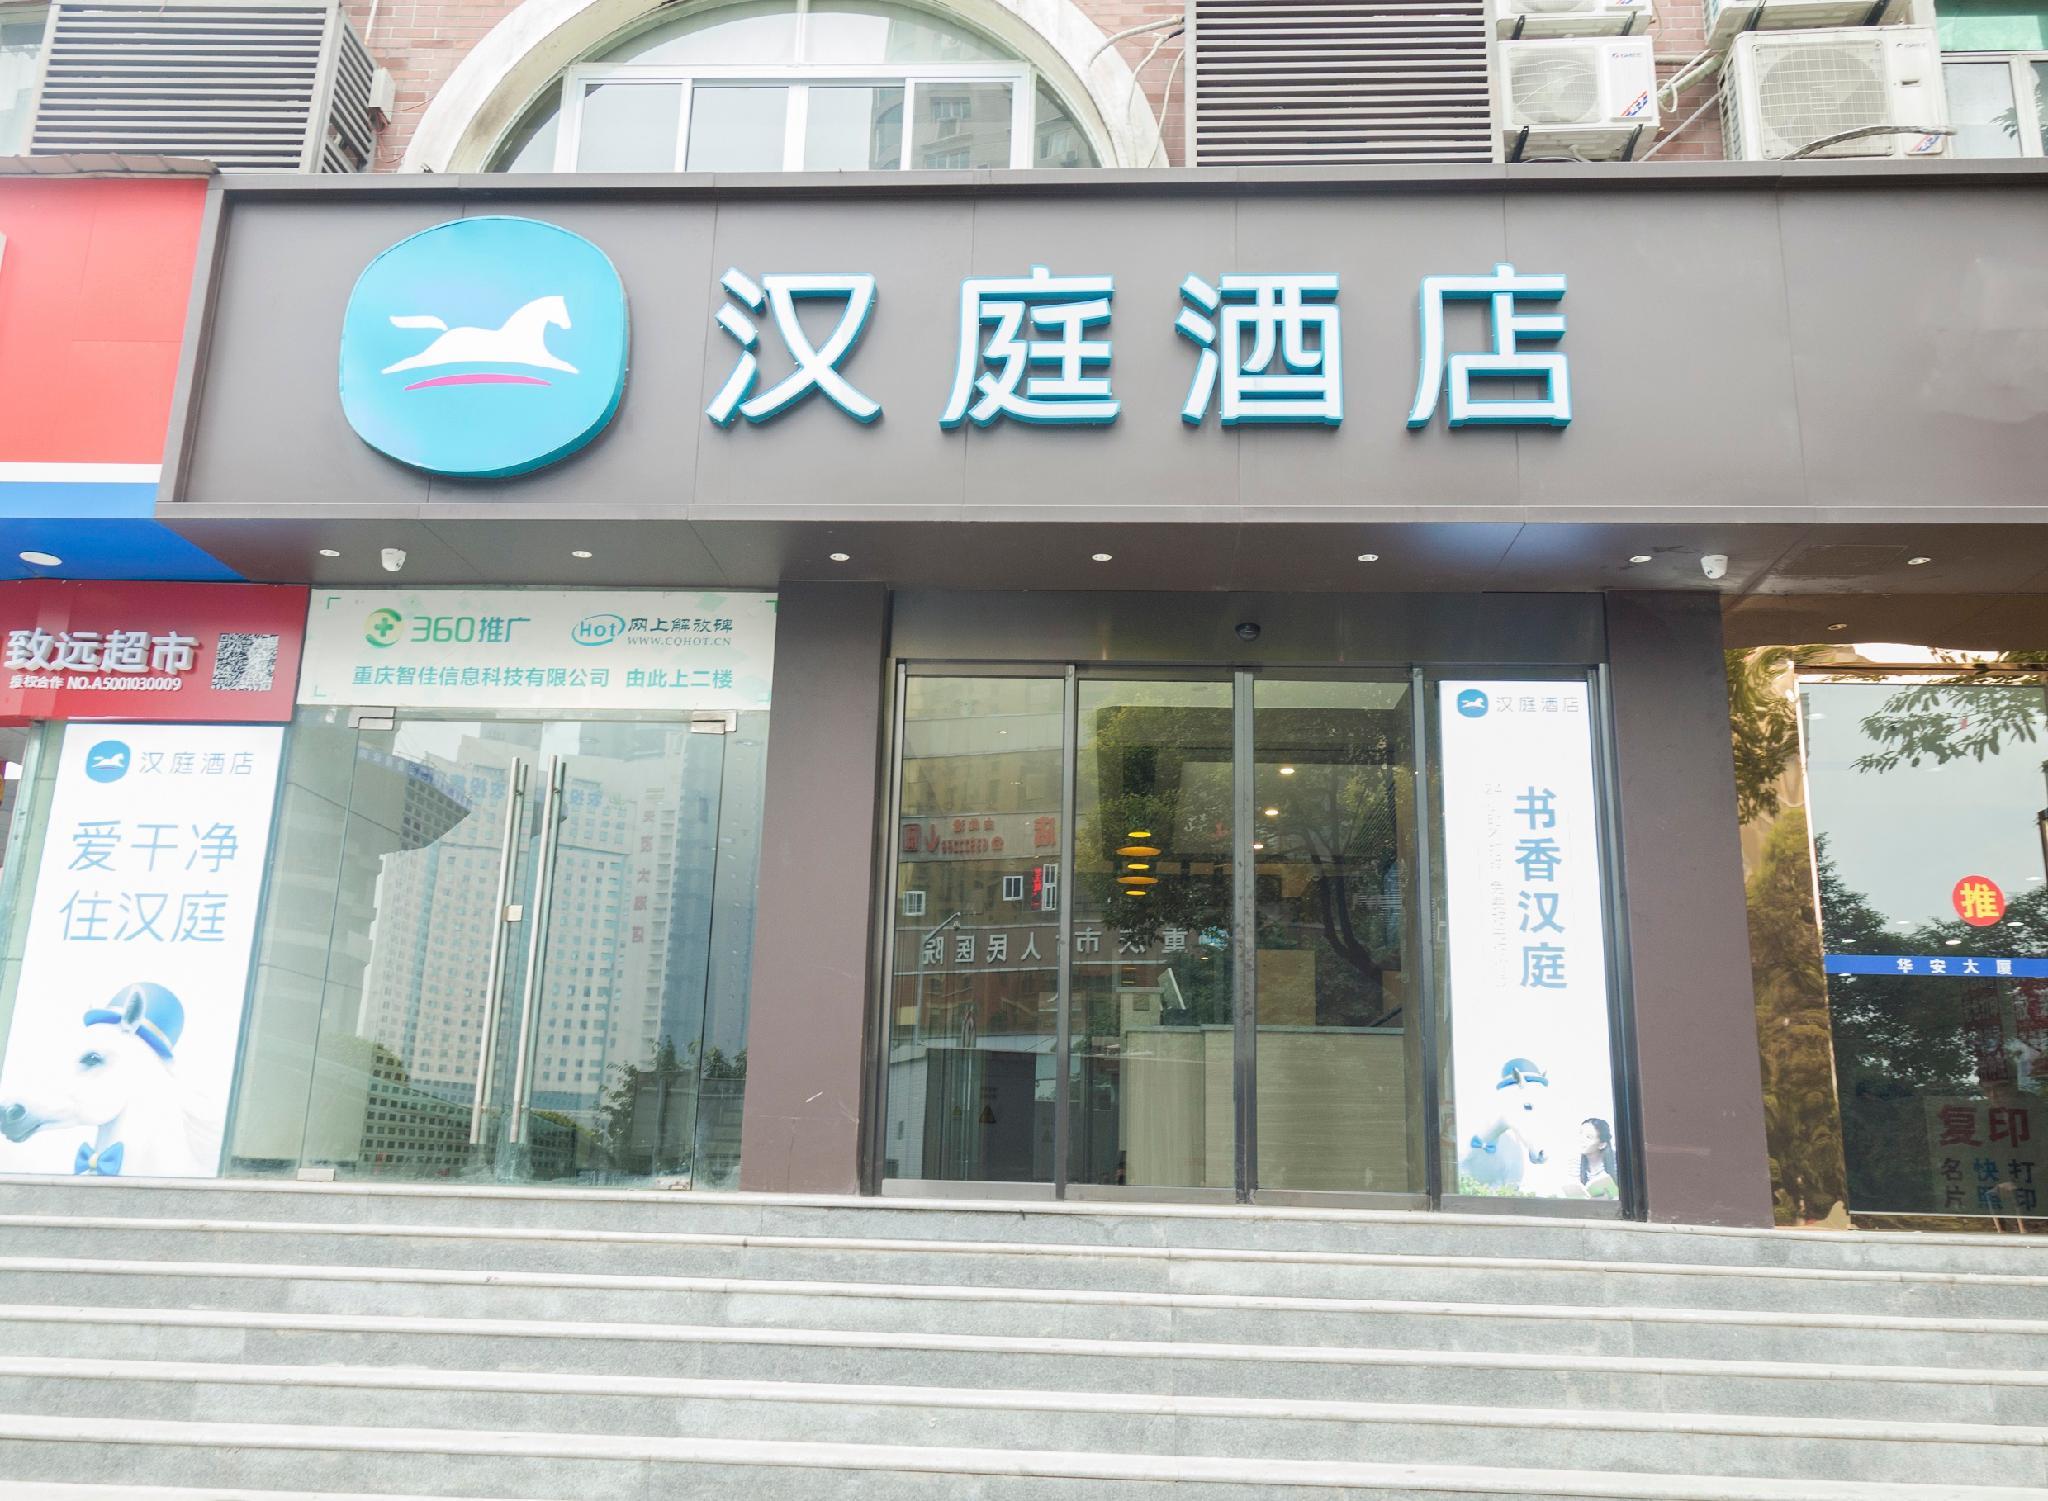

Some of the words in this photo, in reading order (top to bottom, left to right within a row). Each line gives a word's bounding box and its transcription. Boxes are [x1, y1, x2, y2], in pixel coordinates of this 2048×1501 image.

[703, 263, 1573, 429] 汉庭酒店
[410, 616, 532, 643] 360推广
[627, 616, 734, 635] 网上解放碑
[3, 627, 200, 675] 致远超市
[352, 666, 610, 688] 重庆智佳信息科技有限公司
[625, 668, 733, 689] 由此上二楼
[1495, 694, 1580, 714] 汉庭酒店
[138, 750, 255, 776] 汉庭酒店
[67, 819, 239, 873] 爱干净
[1514, 786, 1568, 989] 书香汉庭
[1959, 882, 2000, 919] 推
[58, 889, 229, 943] 住汉庭
[1897, 957, 2013, 975] 华安大厦
[1937, 1105, 2031, 1149] 复印
